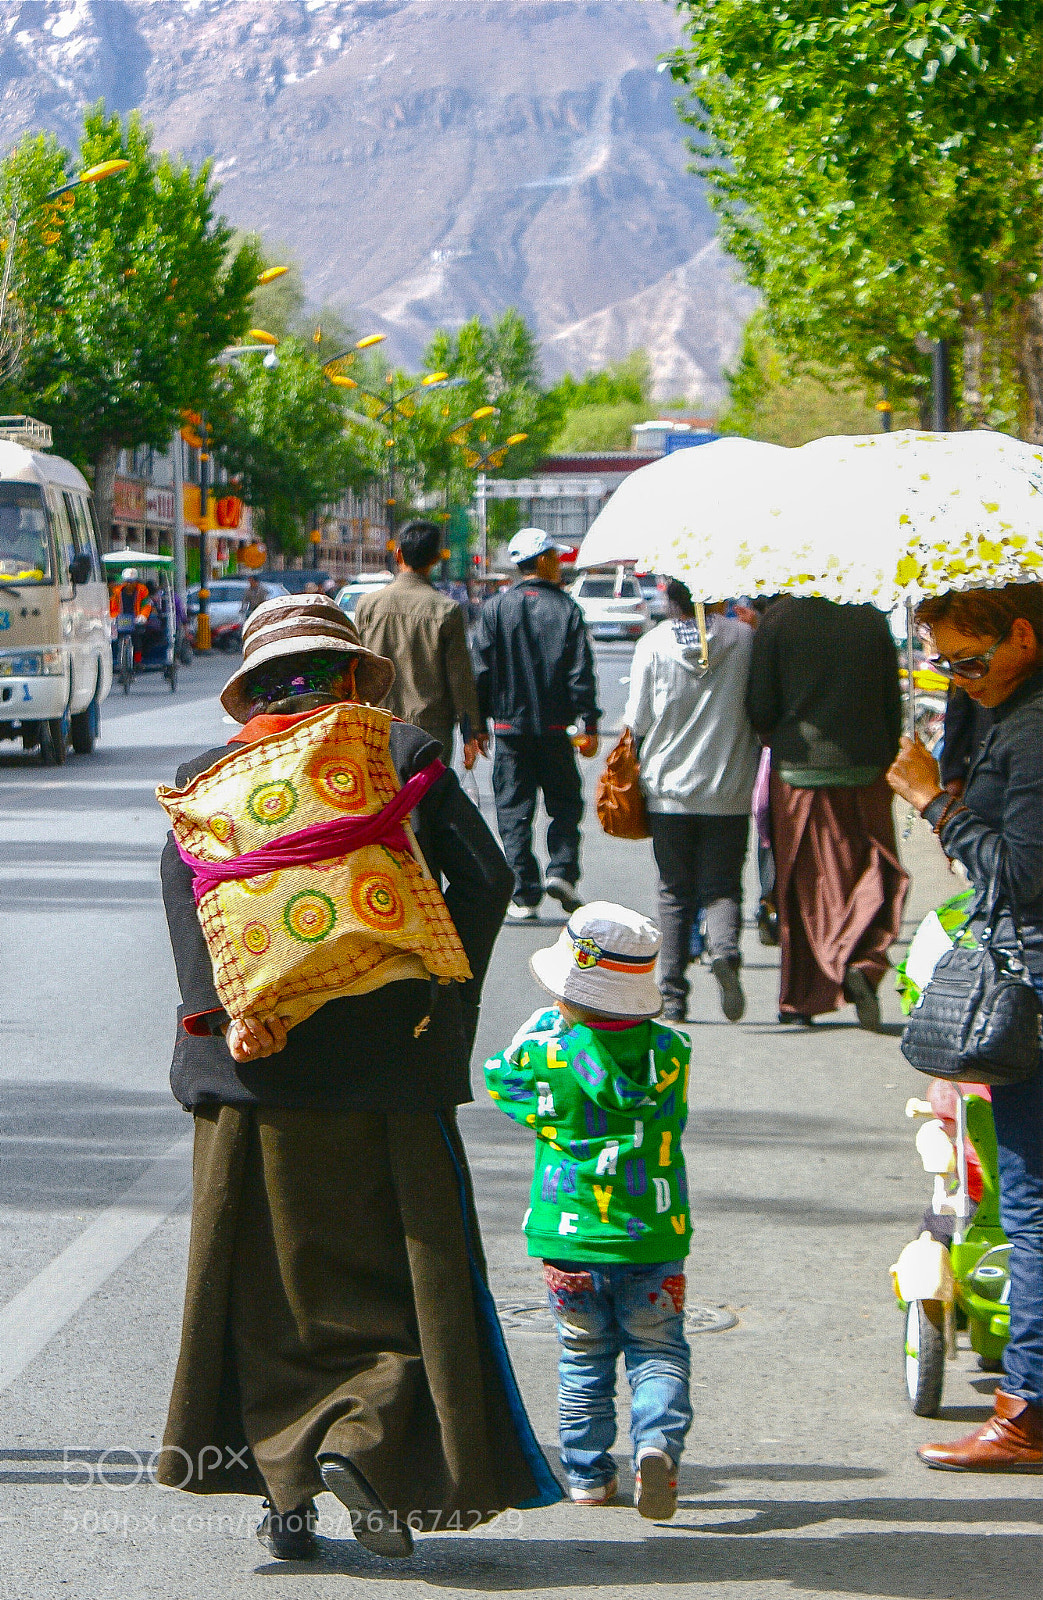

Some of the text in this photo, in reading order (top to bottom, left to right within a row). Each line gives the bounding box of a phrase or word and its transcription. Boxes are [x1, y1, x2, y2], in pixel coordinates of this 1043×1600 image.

[595, 1140, 620, 1176] A
[625, 1157, 648, 1197] U
[592, 1184, 614, 1223] Y
[652, 1177, 672, 1214] D
